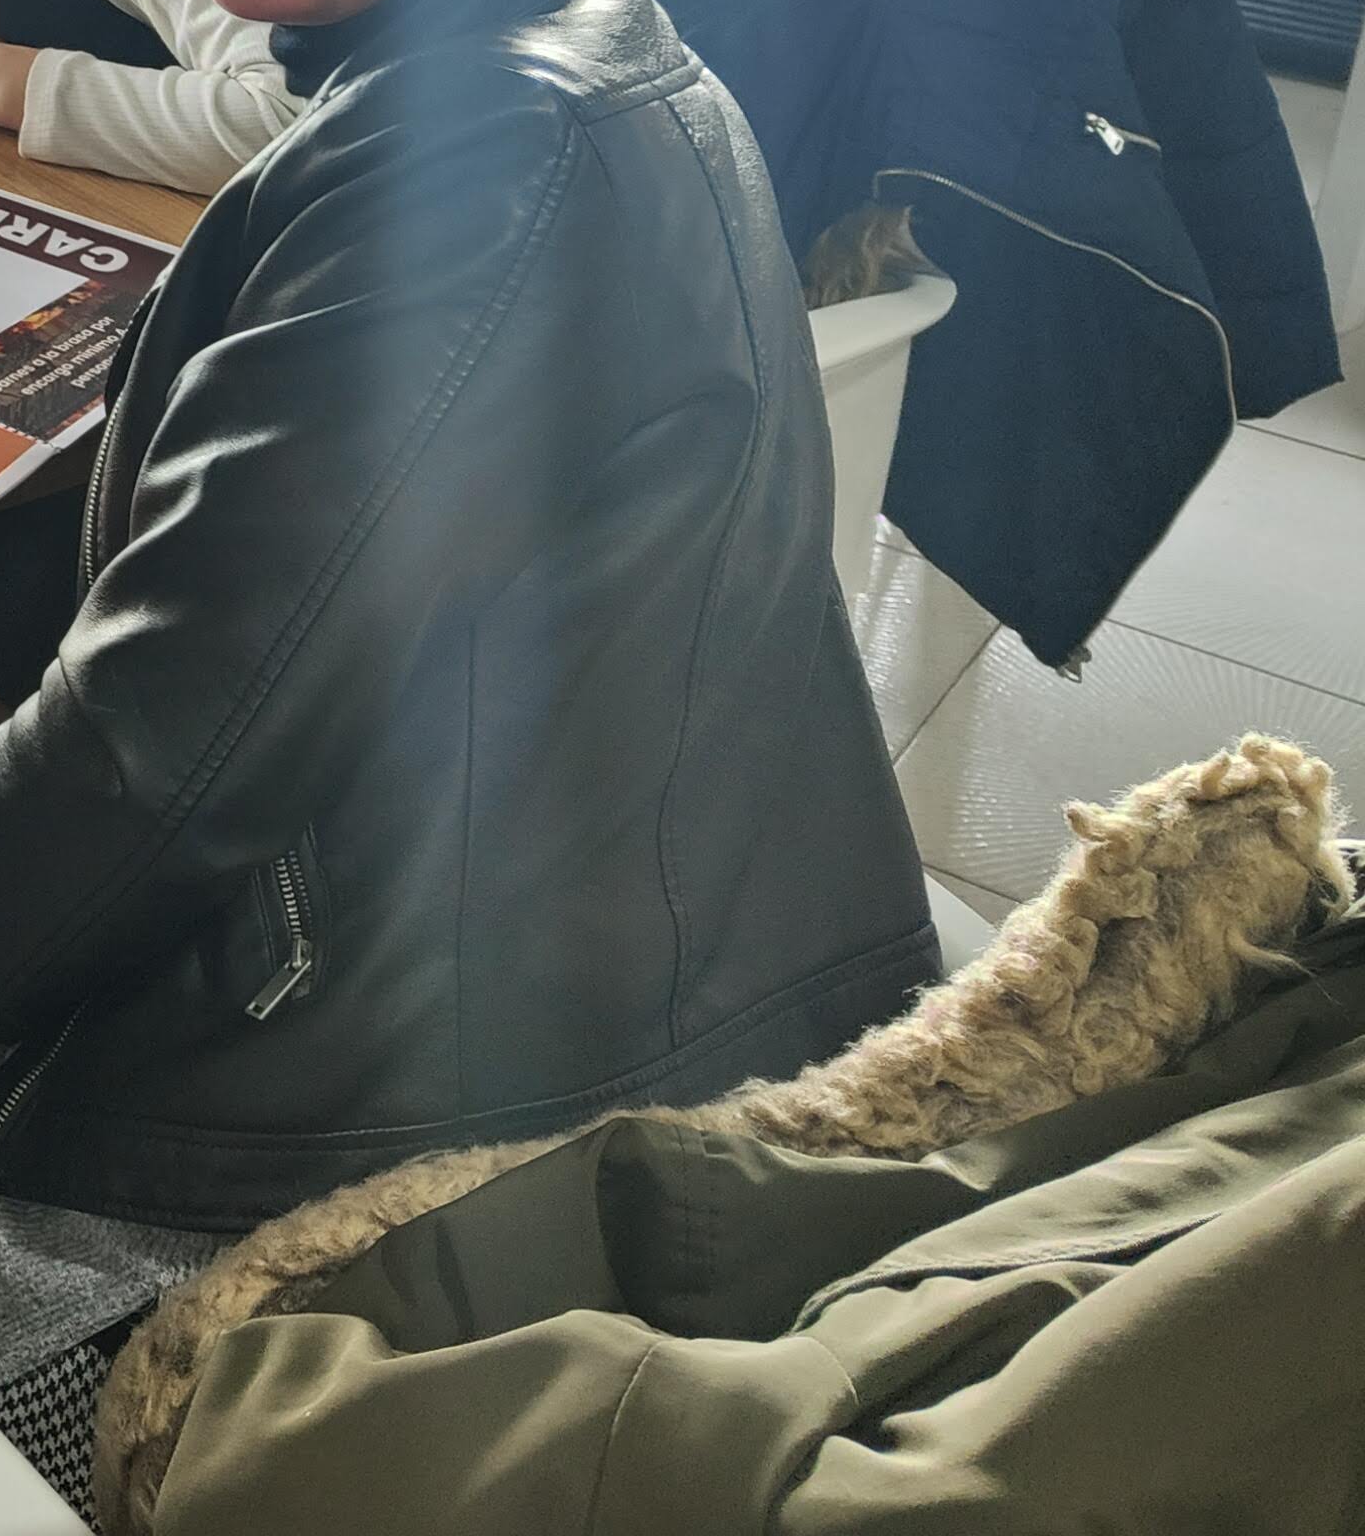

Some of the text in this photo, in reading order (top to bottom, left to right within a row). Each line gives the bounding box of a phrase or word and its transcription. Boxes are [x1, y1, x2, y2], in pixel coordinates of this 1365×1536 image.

[31, 357, 46, 368] a
[41, 348, 61, 362] la
[52, 327, 97, 353] brasa
[89, 315, 116, 334] por
[20, 362, 75, 397] encargo
